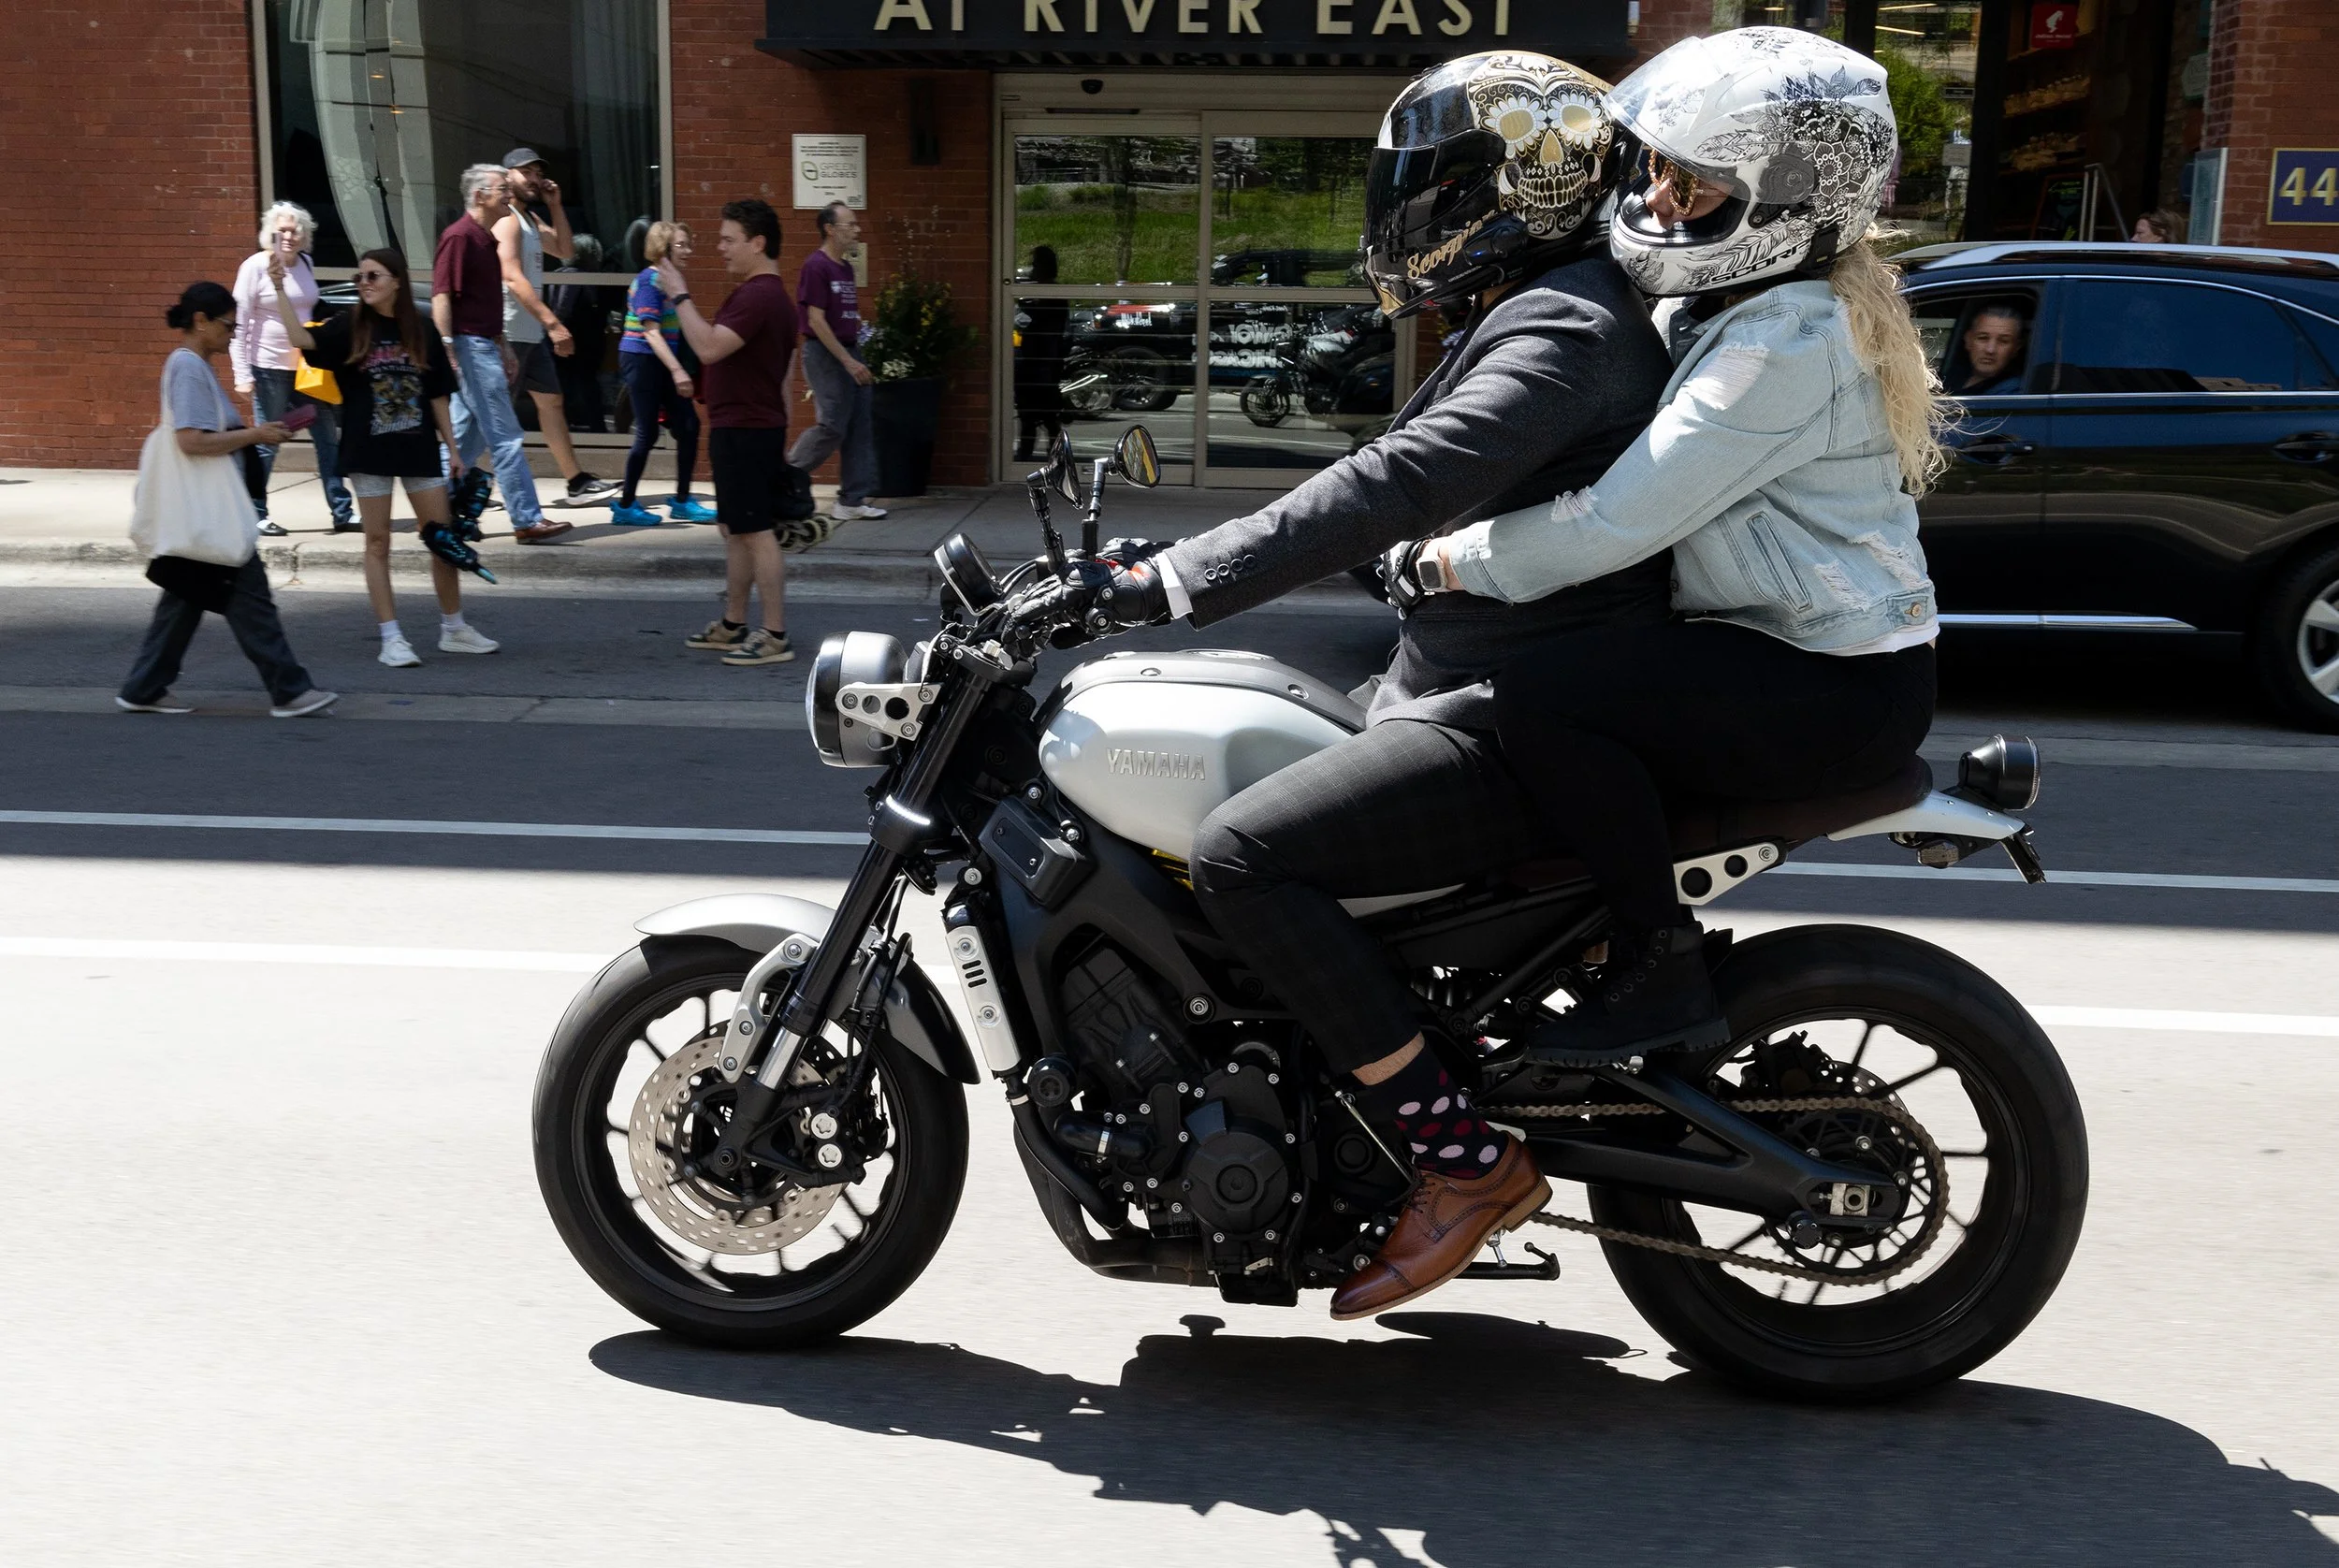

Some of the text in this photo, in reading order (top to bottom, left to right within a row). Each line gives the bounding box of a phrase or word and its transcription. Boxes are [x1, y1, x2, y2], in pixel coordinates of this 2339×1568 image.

[1024, 0, 1263, 34] RIVER
[2279, 167, 2339, 206] 44
[1106, 748, 1205, 780] YAMAHA
